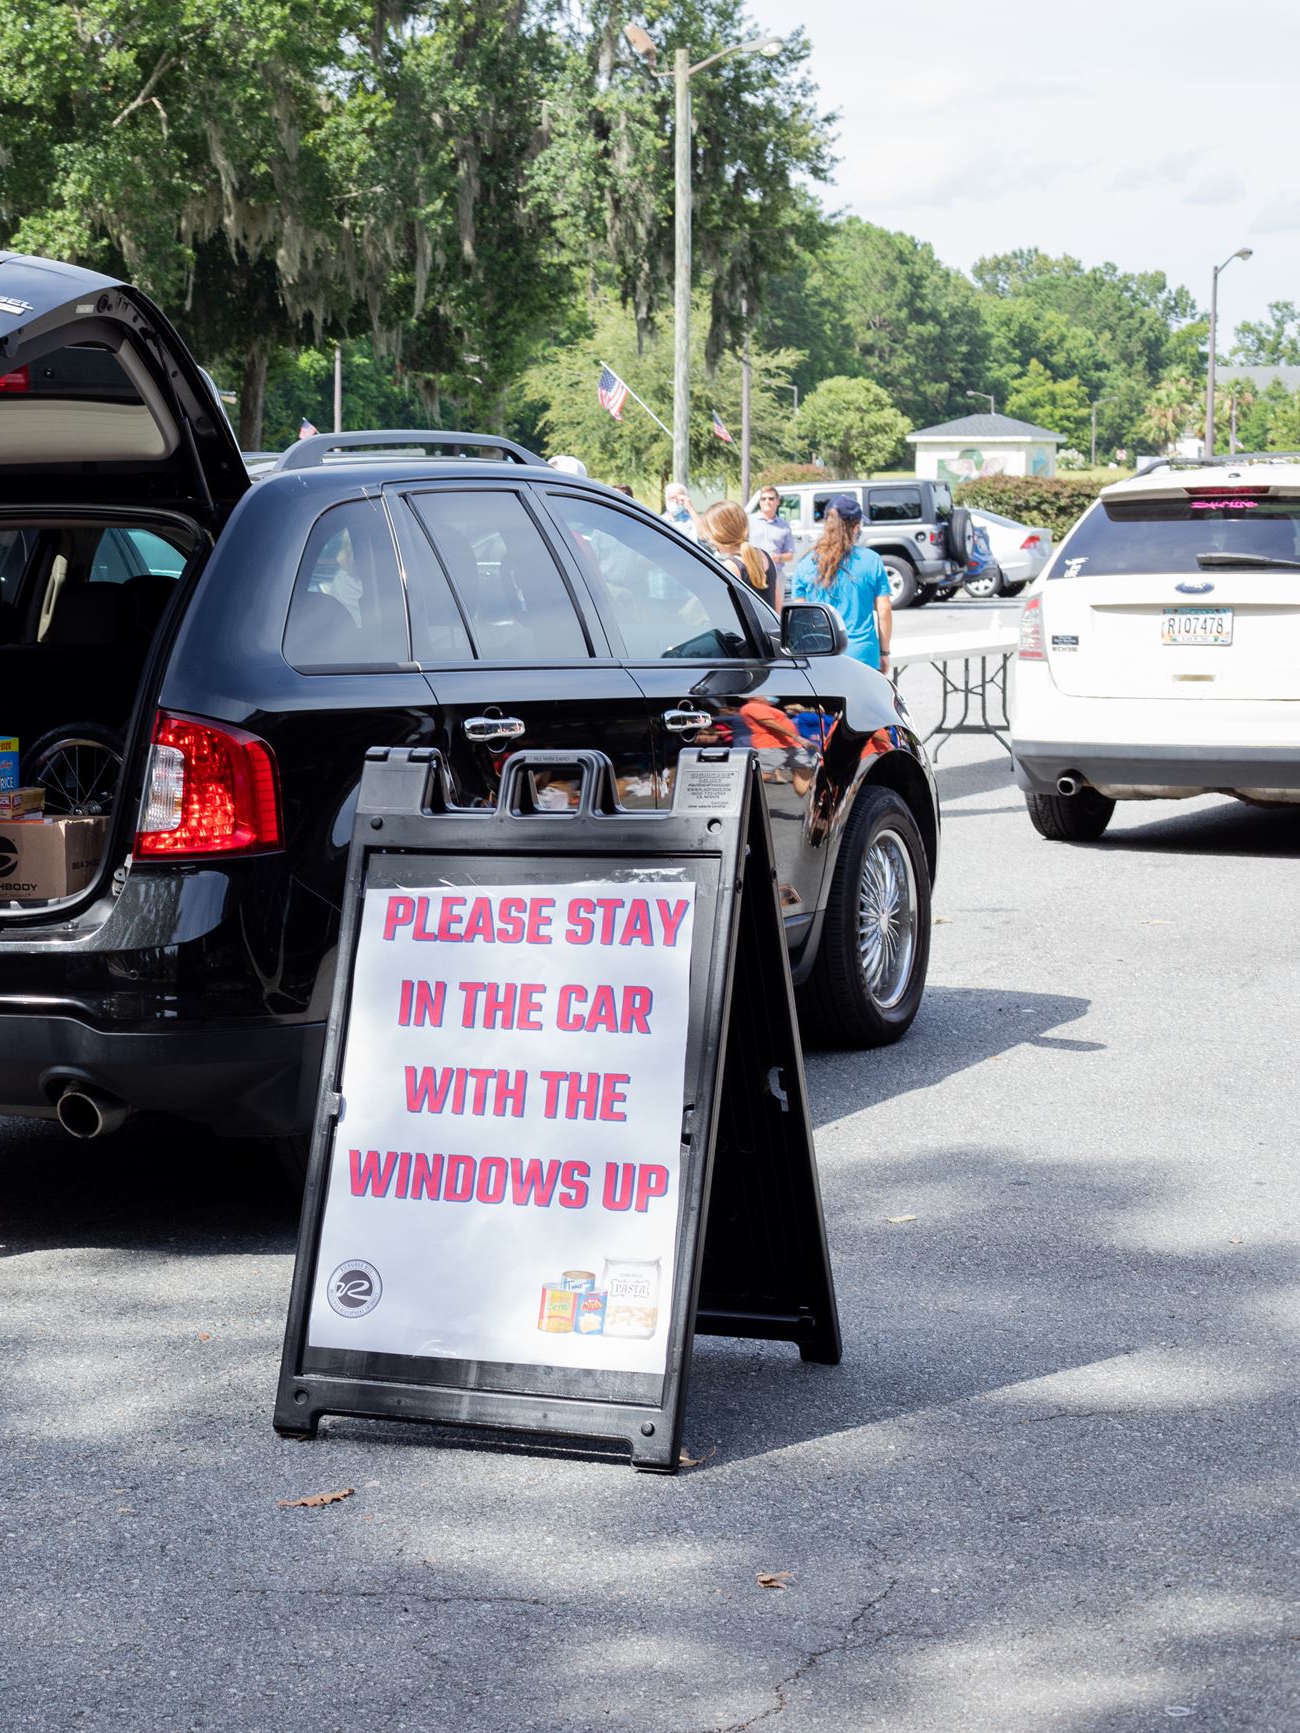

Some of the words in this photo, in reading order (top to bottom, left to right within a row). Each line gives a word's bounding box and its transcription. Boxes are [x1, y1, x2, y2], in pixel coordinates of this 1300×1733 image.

[383, 896, 555, 945] PLEASE
[565, 898, 690, 947] STAY
[398, 980, 447, 1028] IN
[459, 982, 546, 1031] THE
[556, 984, 653, 1035] CAR
[404, 1066, 528, 1118] WITH
[540, 1070, 631, 1122] THE
[349, 1150, 591, 1209] WINDOWS
[602, 1162, 670, 1214] UP
[615, 1283, 646, 1294] PASTA
